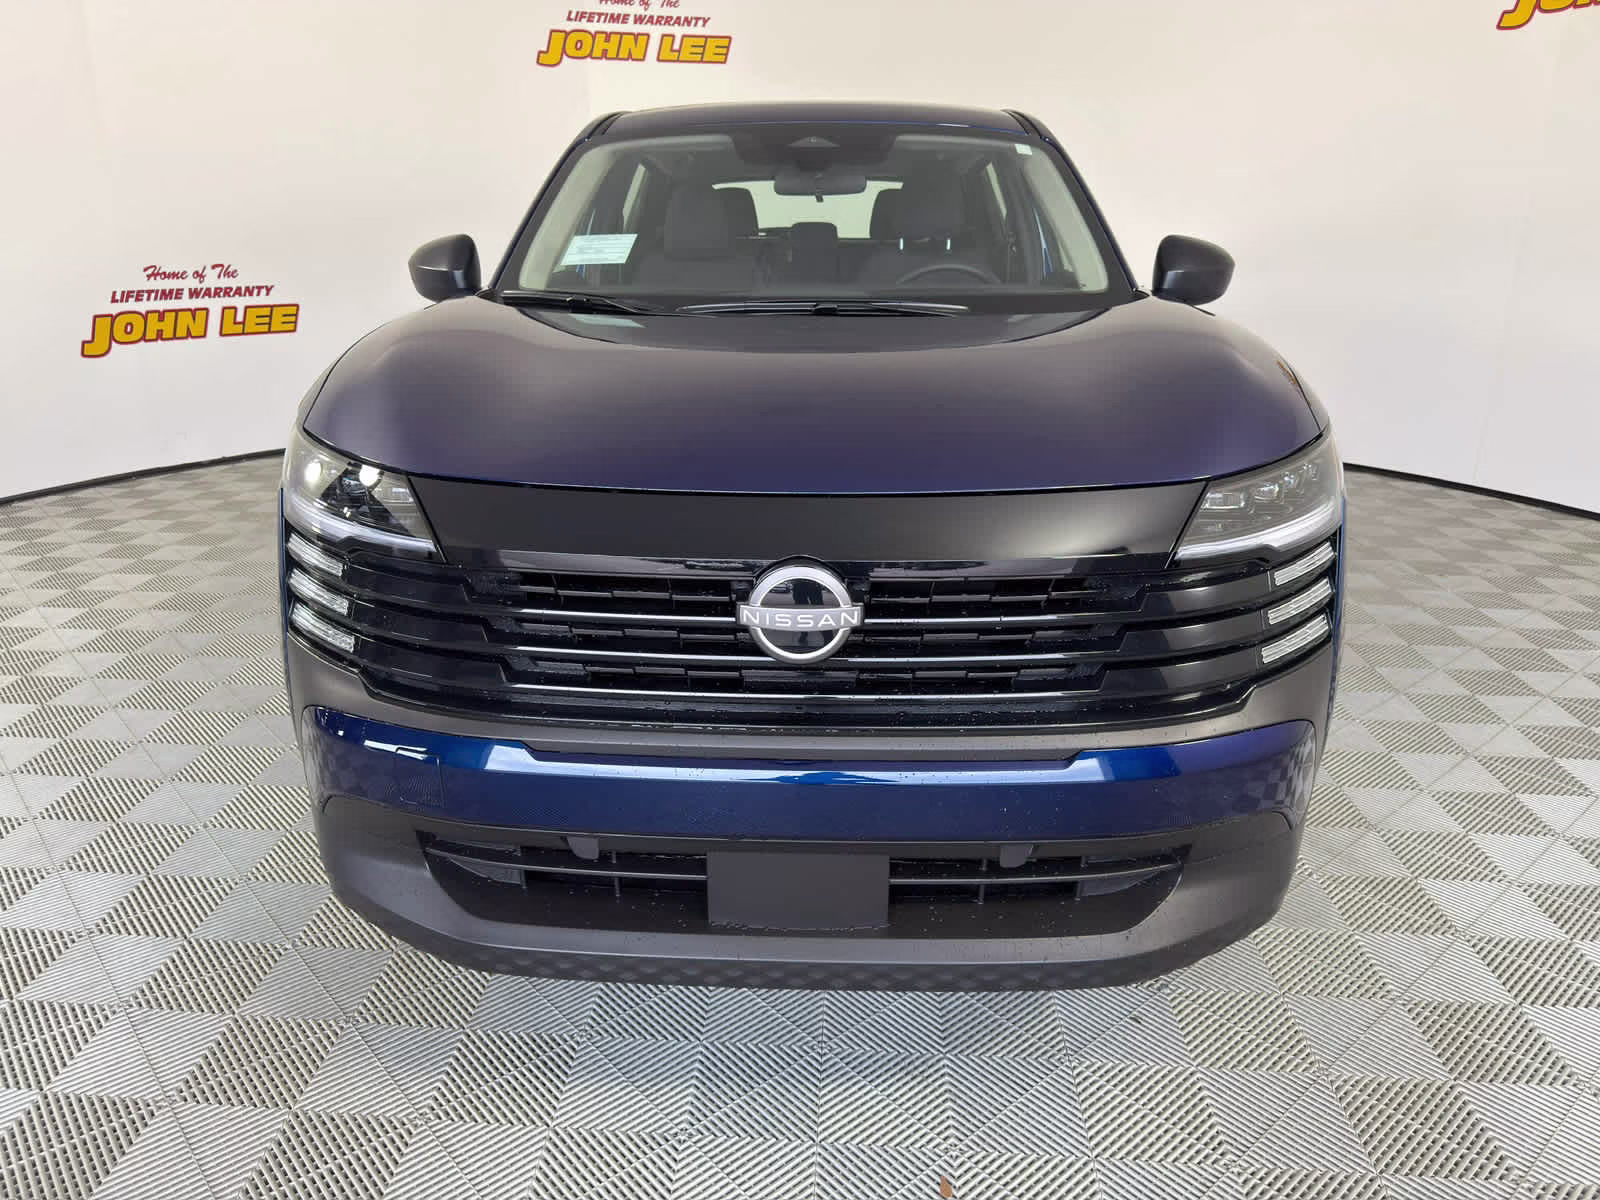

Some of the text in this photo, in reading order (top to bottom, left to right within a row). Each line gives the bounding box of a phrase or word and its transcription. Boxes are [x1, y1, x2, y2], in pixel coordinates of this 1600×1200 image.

[566, 10, 711, 28] LIFETIME WARRANTY
[536, 29, 732, 67] JOHN LEE
[143, 263, 239, 284] Home of The
[110, 285, 275, 304] LIFETIME WARRANTY
[81, 303, 299, 358] JOHN LEE
[743, 609, 858, 628] NISSAN
